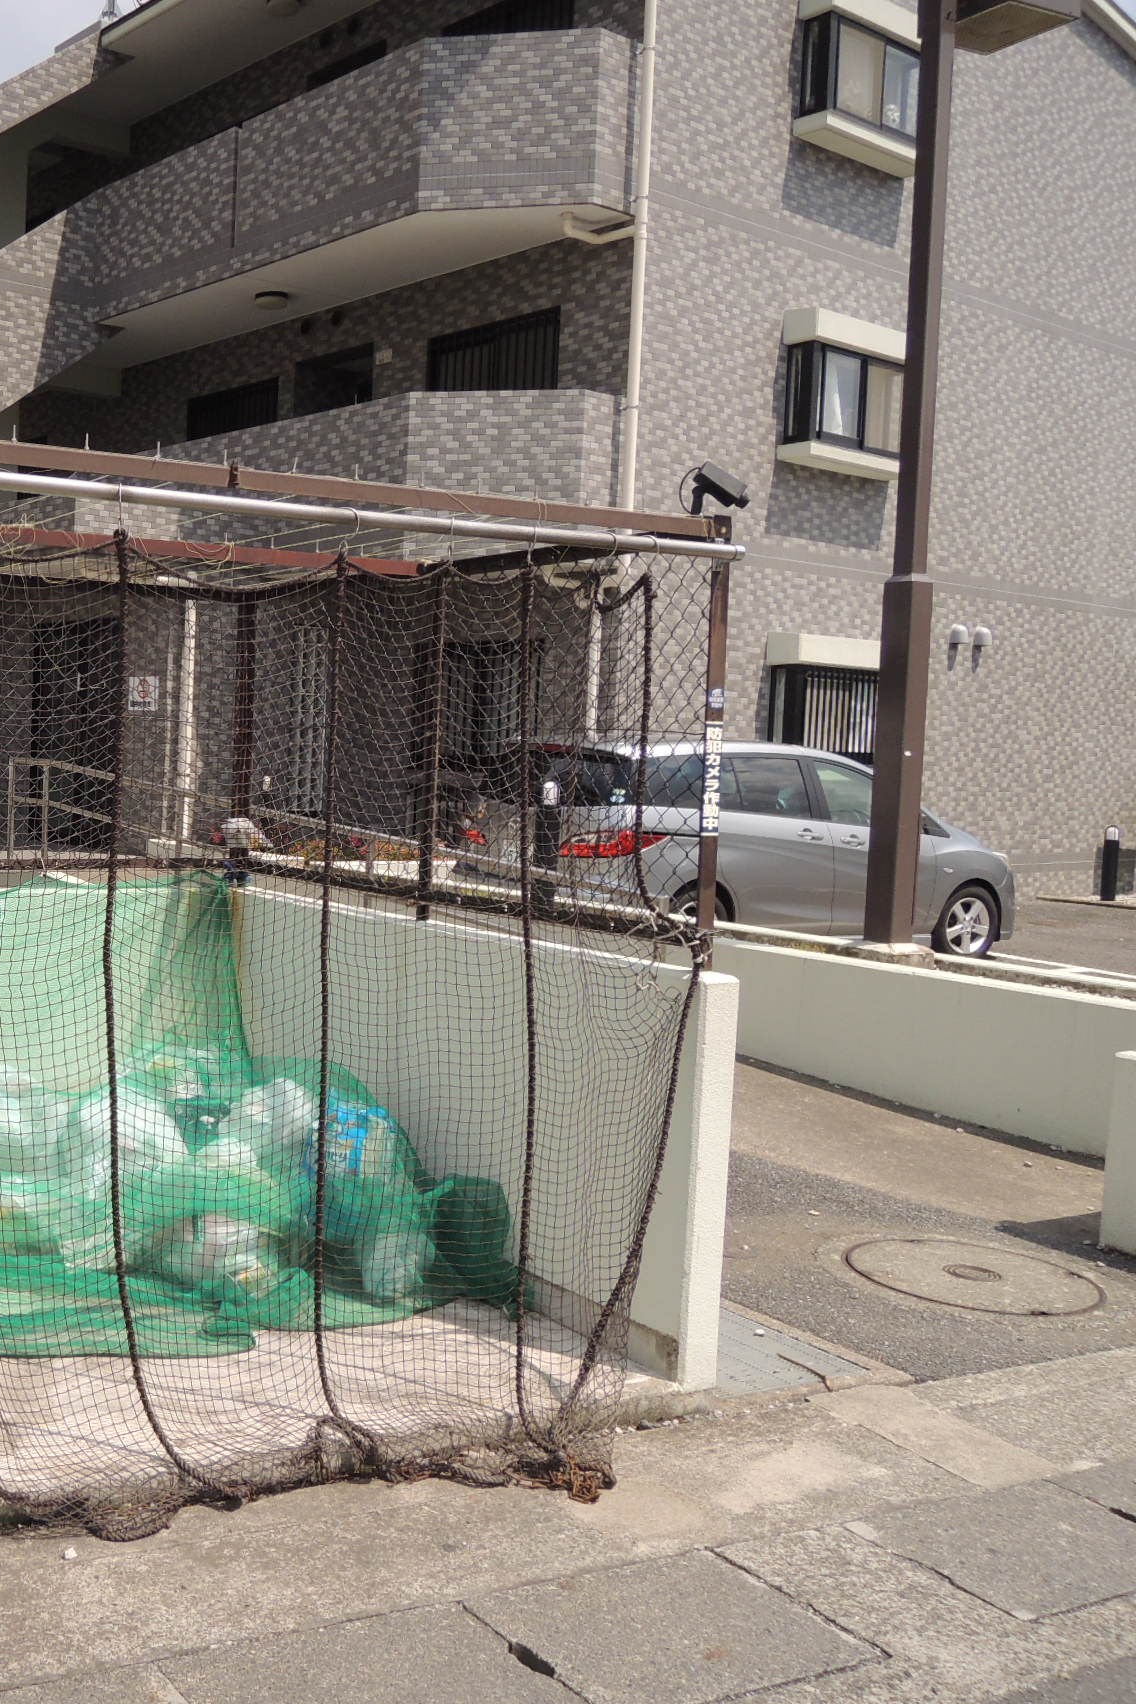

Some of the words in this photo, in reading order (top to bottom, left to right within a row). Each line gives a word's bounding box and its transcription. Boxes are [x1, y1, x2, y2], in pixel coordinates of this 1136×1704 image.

[703, 727, 722, 830] 防犯カメラ作動中
